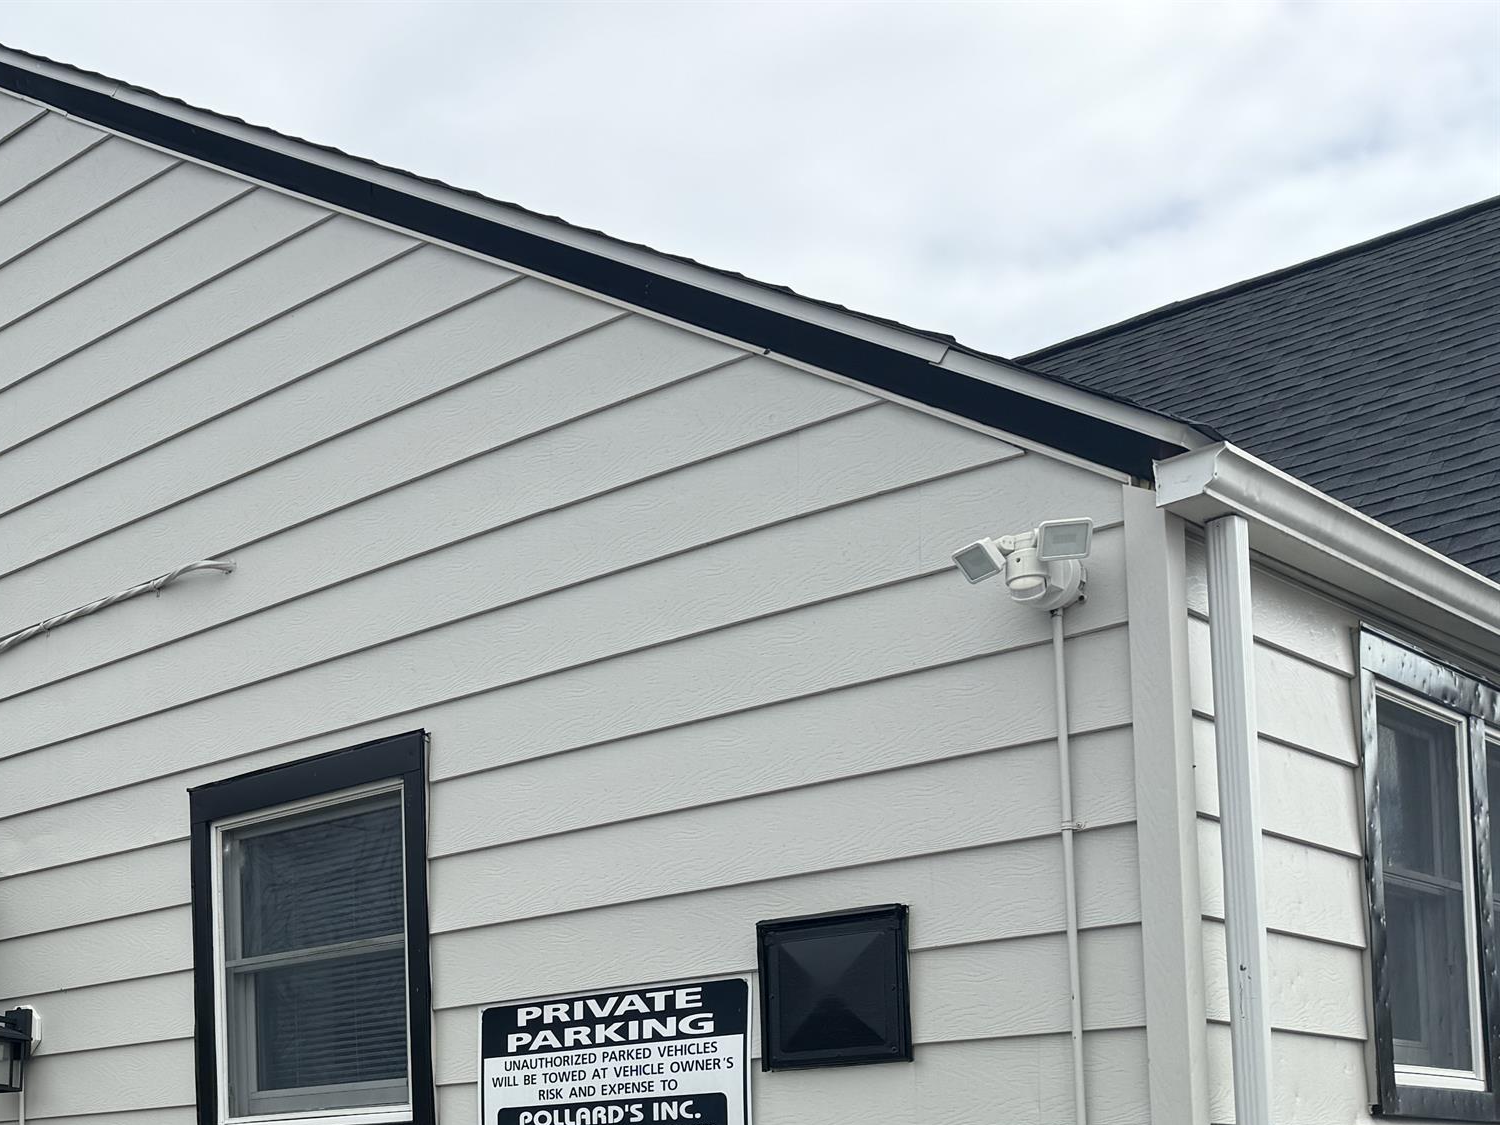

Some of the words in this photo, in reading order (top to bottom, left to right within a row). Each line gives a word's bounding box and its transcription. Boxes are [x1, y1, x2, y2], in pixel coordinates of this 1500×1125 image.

[517, 987, 703, 1027] PRIVATE
[507, 1013, 715, 1053] PARKING
[492, 1075, 519, 1088] WILL
[523, 1074, 537, 1086] BE
[542, 1070, 587, 1085] TOWED
[592, 1068, 609, 1081] AT
[613, 1063, 664, 1078] VEHICLE
[669, 1056, 734, 1073] OWNER'S
[504, 1053, 597, 1072] UNAUTHORIZED
[602, 1047, 652, 1063] PARKED
[657, 1041, 718, 1058] VEHICLES
[538, 1088, 564, 1101] RISK
[569, 1085, 596, 1099] AND
[601, 1081, 655, 1097] EXPENSE
[660, 1079, 678, 1091] TO
[652, 1100, 702, 1121] INC.
